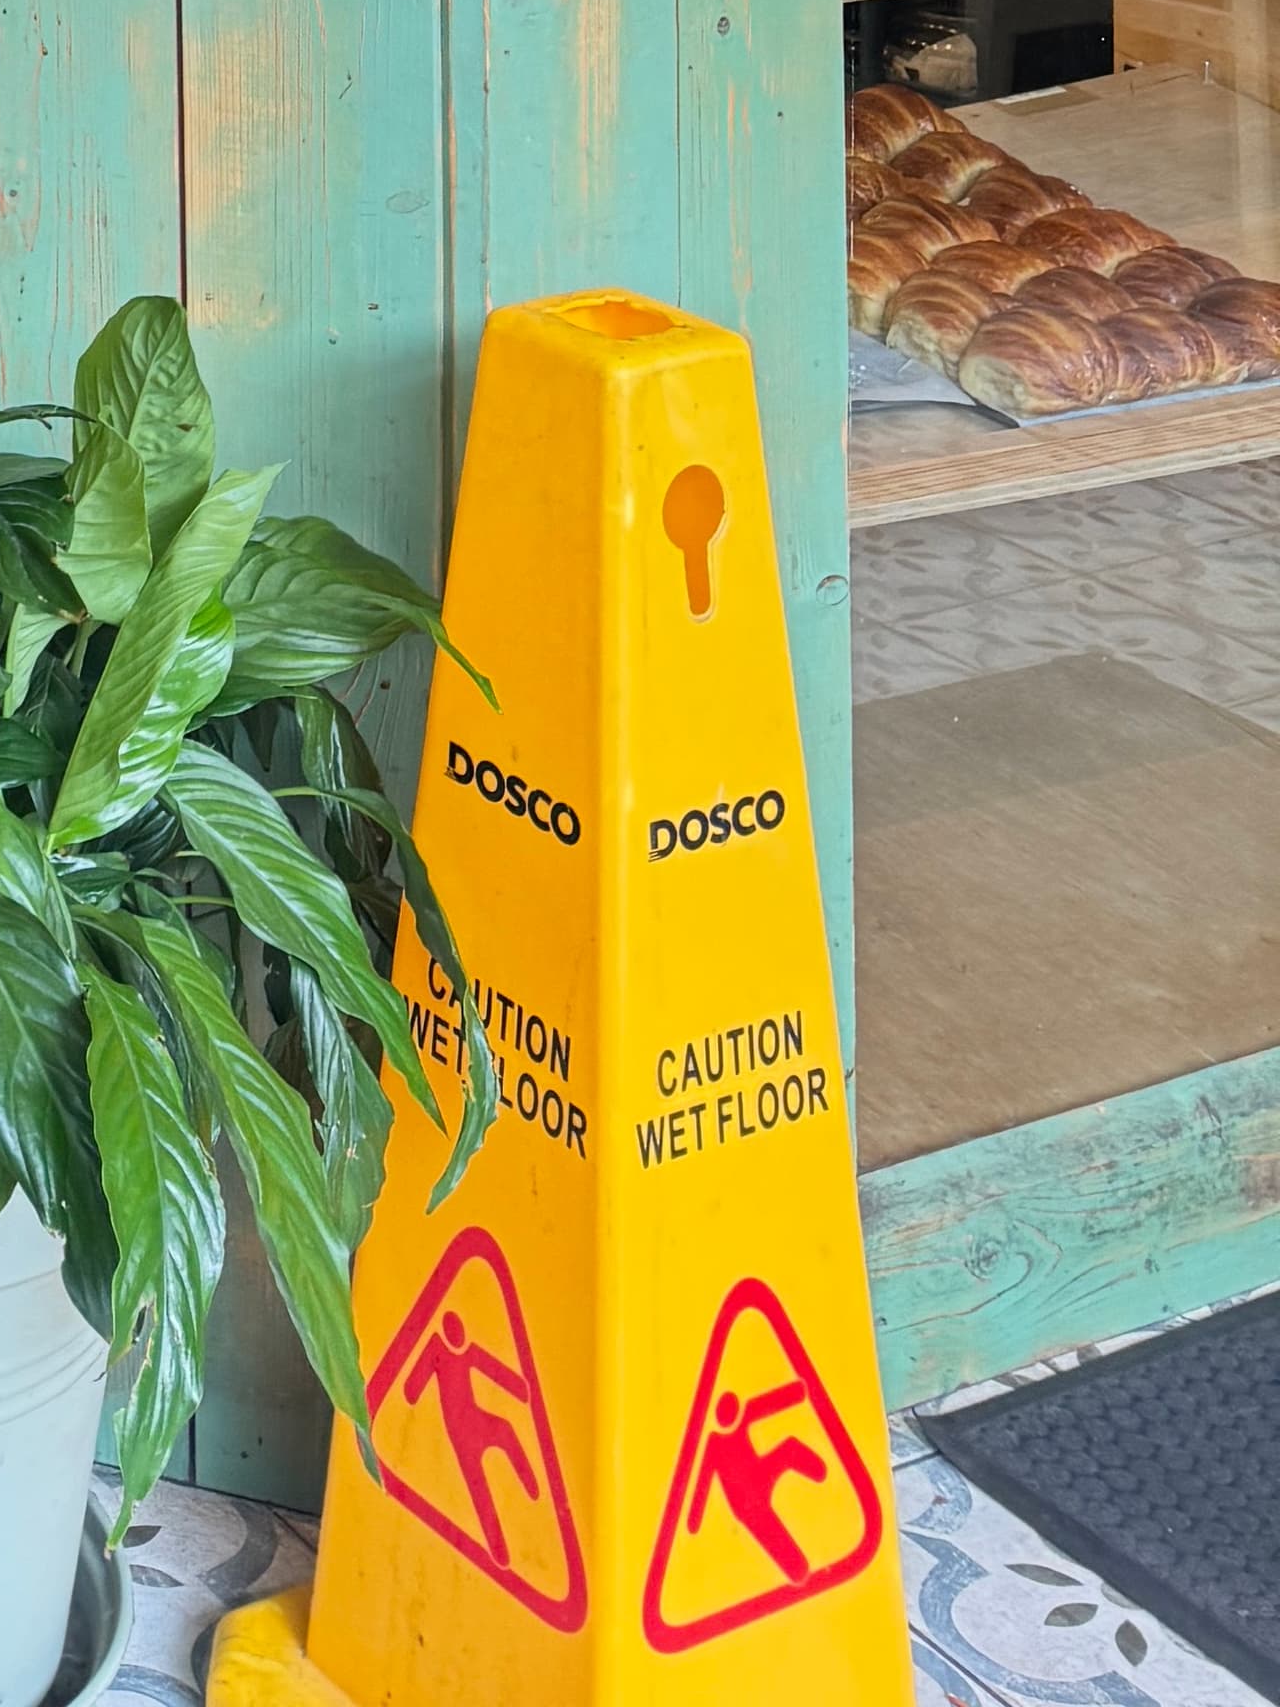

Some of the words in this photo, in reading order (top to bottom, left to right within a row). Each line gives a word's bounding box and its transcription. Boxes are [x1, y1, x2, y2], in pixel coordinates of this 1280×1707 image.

[445, 739, 581, 848] DOSCO
[647, 787, 785, 863] DOSCO
[461, 1049, 587, 1161] LOOR
[656, 1011, 805, 1099] CAUTION
[635, 1101, 704, 1170] WET
[716, 1066, 830, 1145] FLOOR
